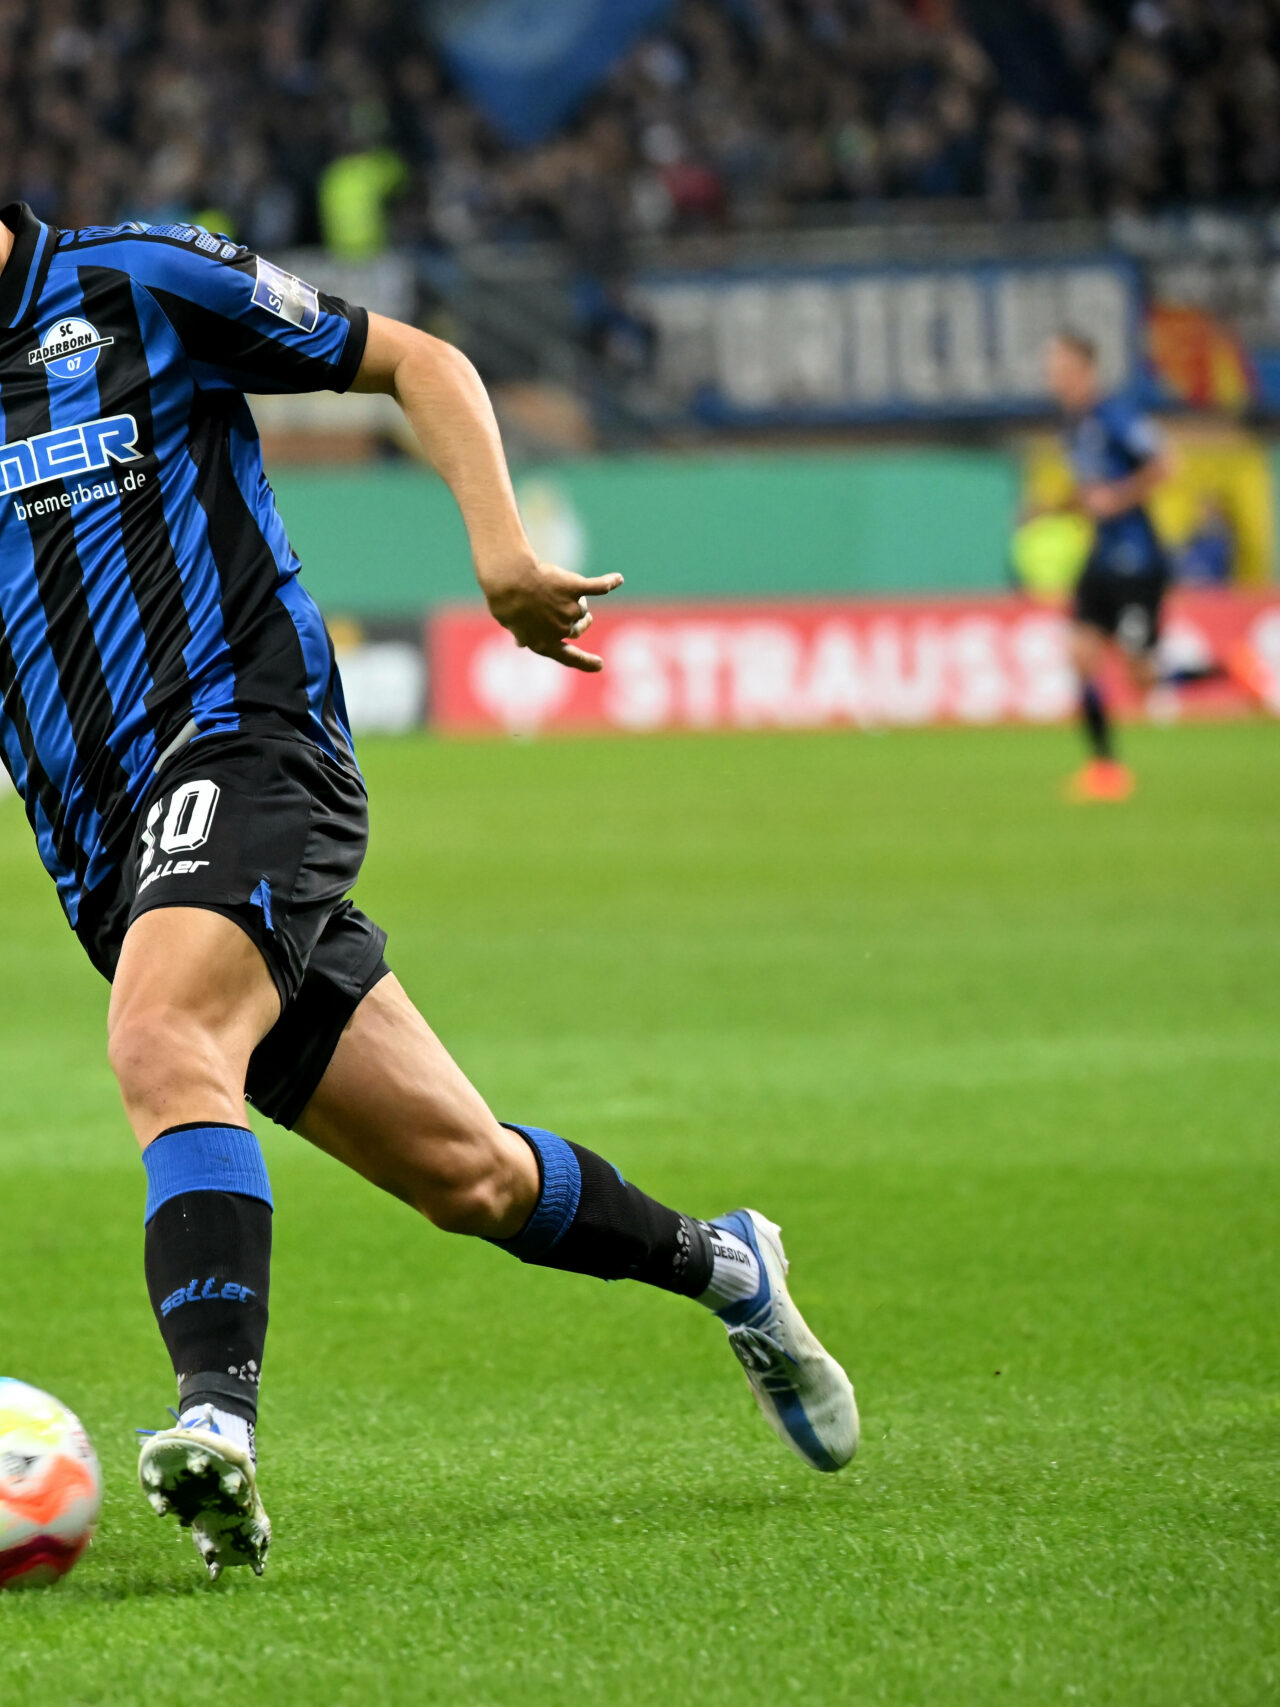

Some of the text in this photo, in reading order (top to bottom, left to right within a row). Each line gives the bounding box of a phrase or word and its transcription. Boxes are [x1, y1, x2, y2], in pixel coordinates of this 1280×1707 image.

[29, 332, 92, 363] PADERBORN
[59, 323, 73, 337] SC
[66, 356, 82, 372] 07
[13, 470, 147, 521] bremerbau.de
[604, 610, 1078, 732] STRAUSS
[160, 1276, 257, 1318] saller
